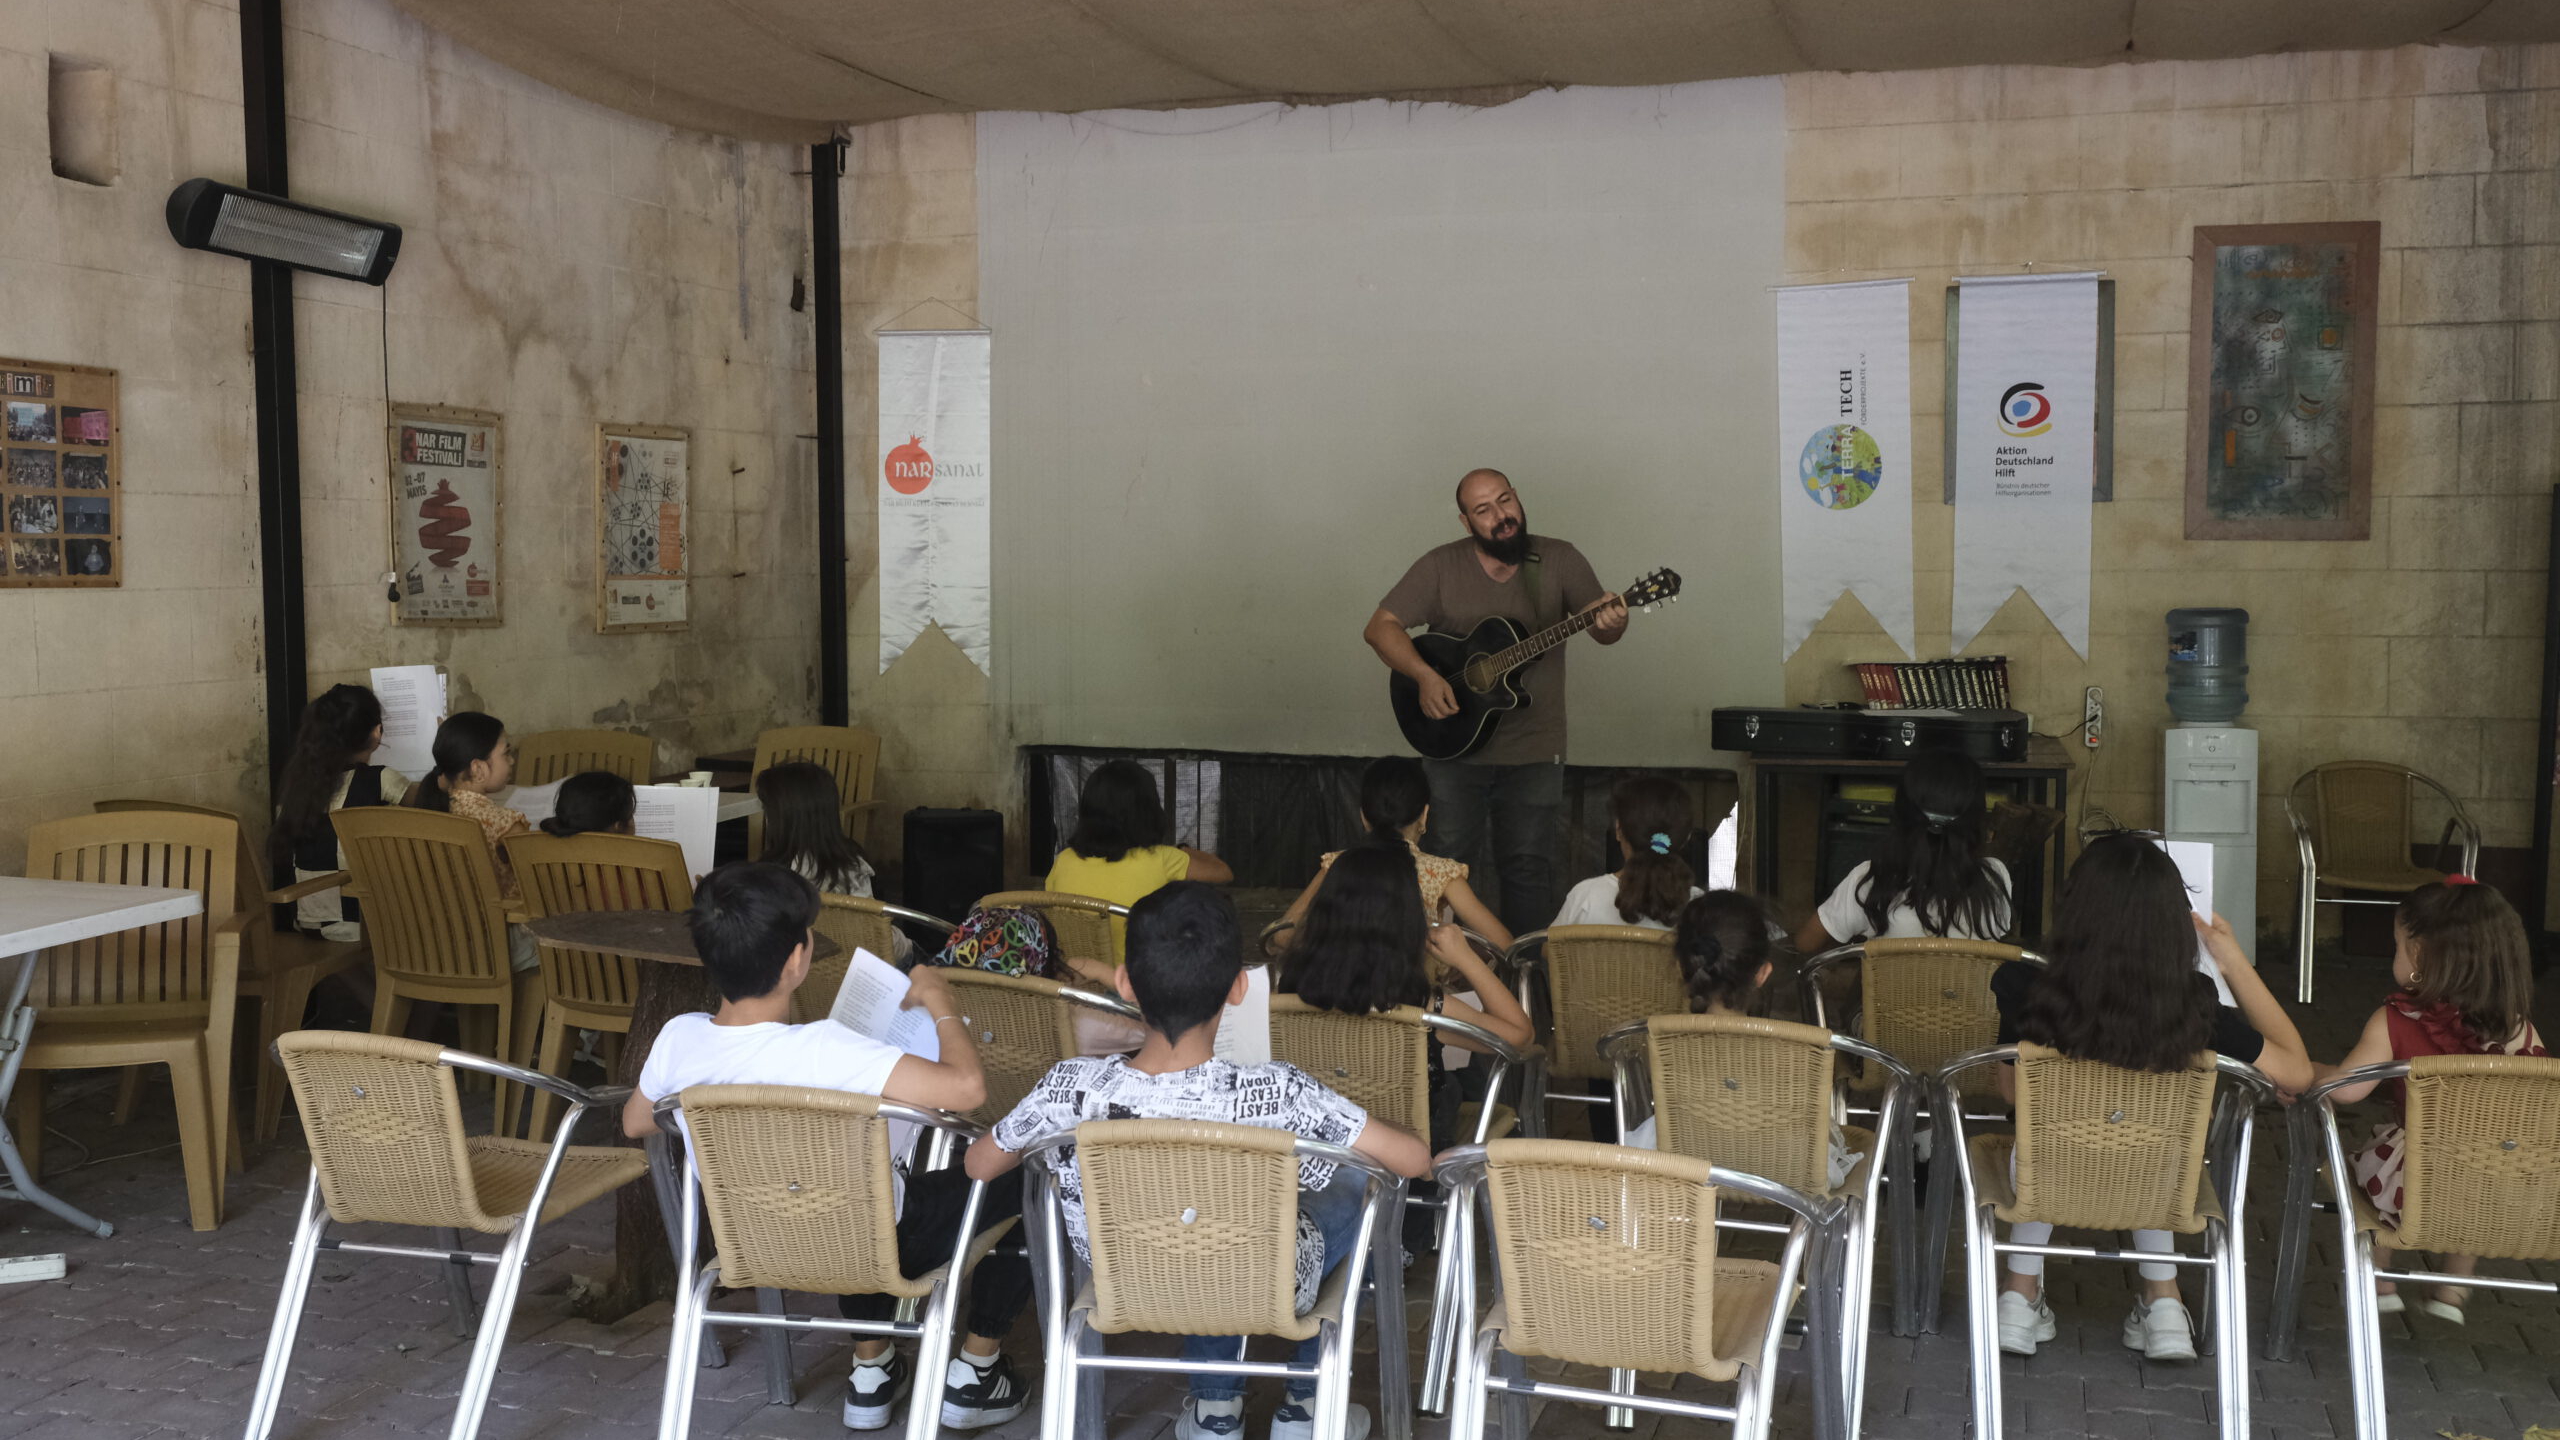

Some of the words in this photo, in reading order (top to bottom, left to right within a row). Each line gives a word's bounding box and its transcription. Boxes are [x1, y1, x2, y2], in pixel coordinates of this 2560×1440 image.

[1839, 369, 1853, 417] TECH
[415, 432, 436, 449] NAR
[1840, 425, 1854, 480] TERRA
[1996, 446, 2027, 455] Aktion
[1995, 456, 2054, 466] Deutschland
[1995, 468, 2016, 477] Hilft
[1045, 1074, 1079, 1089] FEAST
[1239, 1073, 1278, 1090] TODAY
[1046, 1089, 1071, 1104] BEAS
[1241, 1086, 1281, 1103] FEAST
[1239, 1101, 1279, 1119] BEAST
